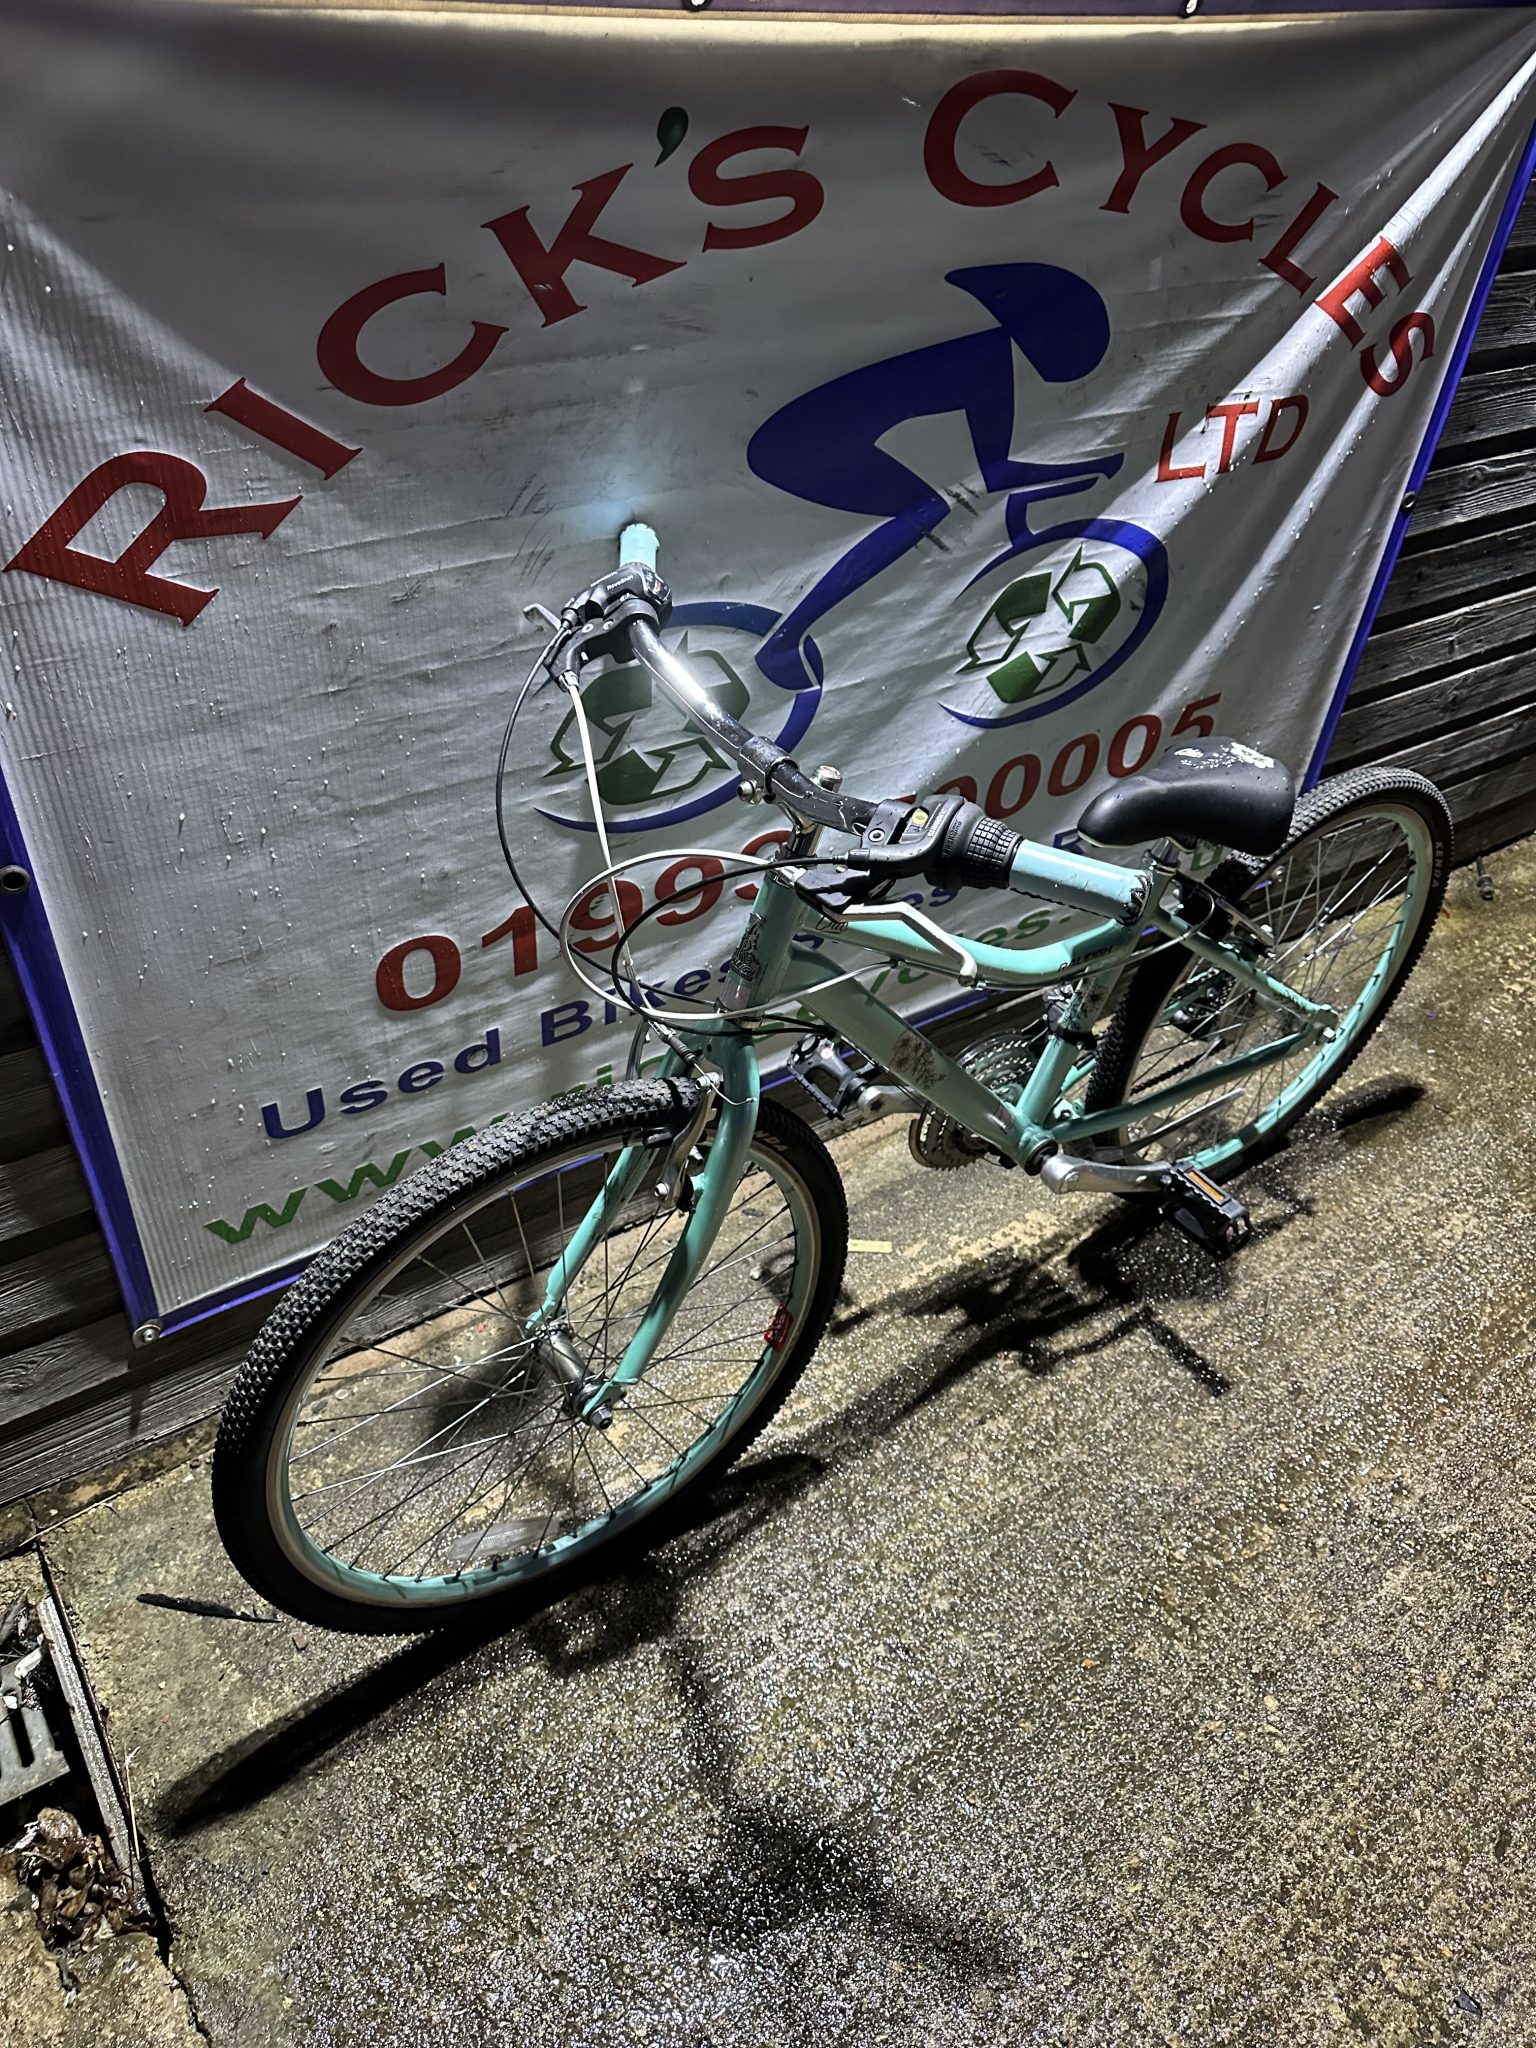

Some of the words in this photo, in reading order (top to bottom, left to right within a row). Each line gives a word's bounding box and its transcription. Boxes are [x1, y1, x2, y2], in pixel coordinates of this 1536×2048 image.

[3, 106, 825, 627] RICK'S
[924, 69, 1435, 397] CYCLES
[1154, 393, 1310, 483] LTD
[893, 692, 1222, 820] 0005
[1433, 841, 1444, 887] KENDA
[259, 1027, 501, 1139] Used
[541, 961, 731, 1047] Bike
[755, 1129, 789, 1152] NDA
